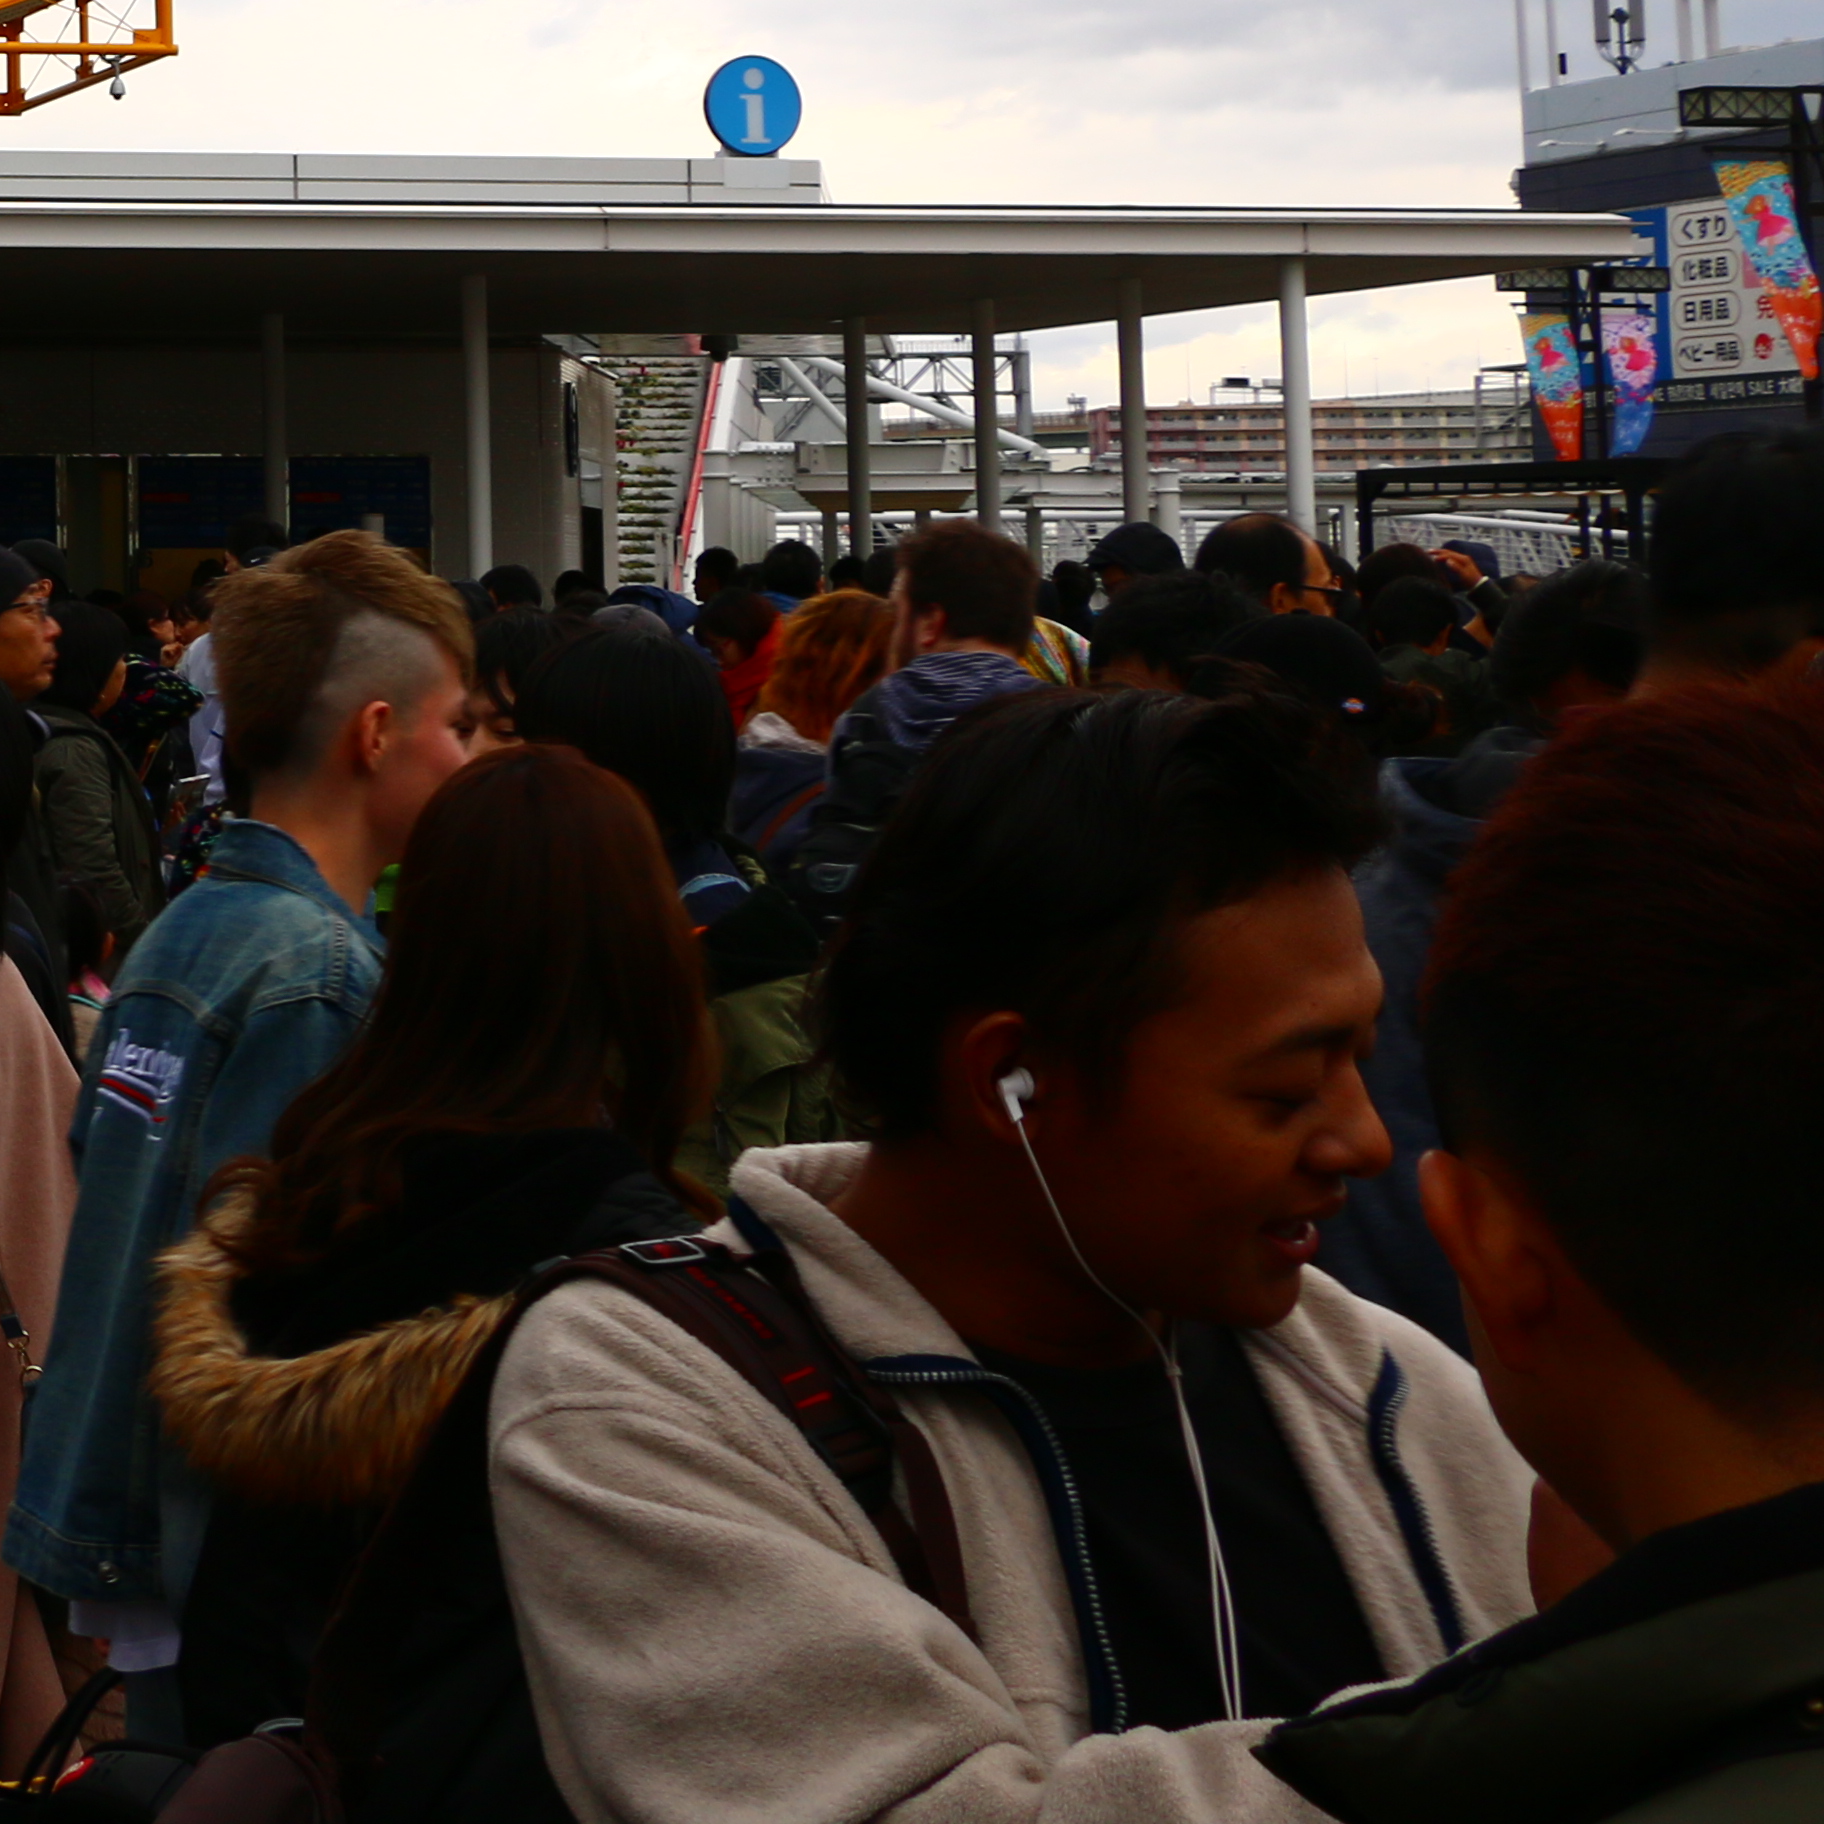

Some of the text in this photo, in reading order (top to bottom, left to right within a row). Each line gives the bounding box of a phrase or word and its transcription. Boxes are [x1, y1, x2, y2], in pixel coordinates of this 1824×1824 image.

[1682, 215, 1727, 240] くすり
[1683, 256, 1729, 282] 化粧品
[1684, 297, 1730, 323] 日用品
[1679, 340, 1741, 363] ベビー用品
